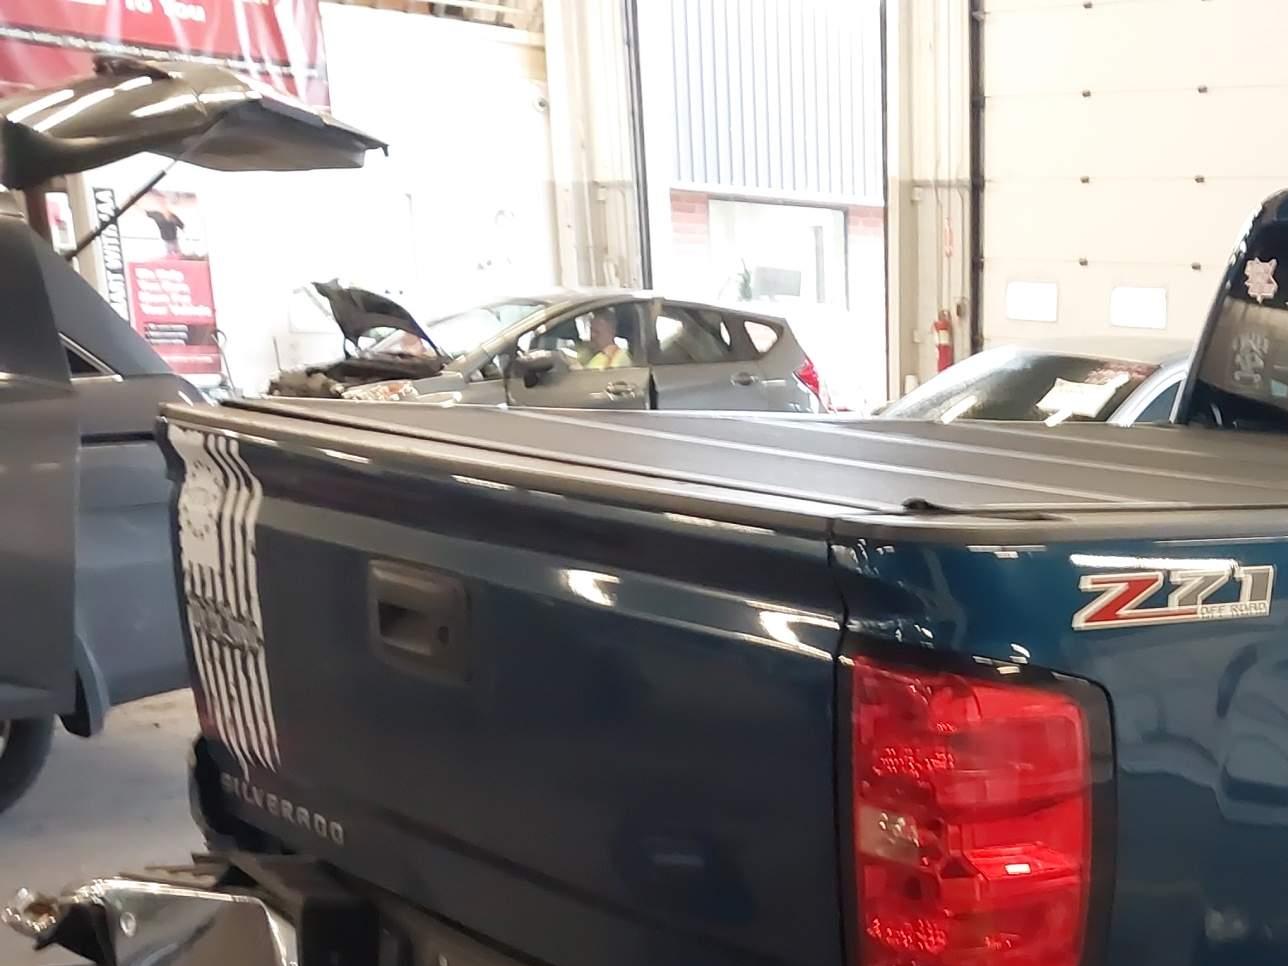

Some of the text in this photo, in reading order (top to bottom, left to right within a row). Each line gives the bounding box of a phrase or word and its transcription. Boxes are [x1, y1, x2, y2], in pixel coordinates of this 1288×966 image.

[1072, 565, 1275, 631] Z71
[1200, 602, 1266, 618] OFF ROAD
[220, 771, 344, 847] SILVERADO
